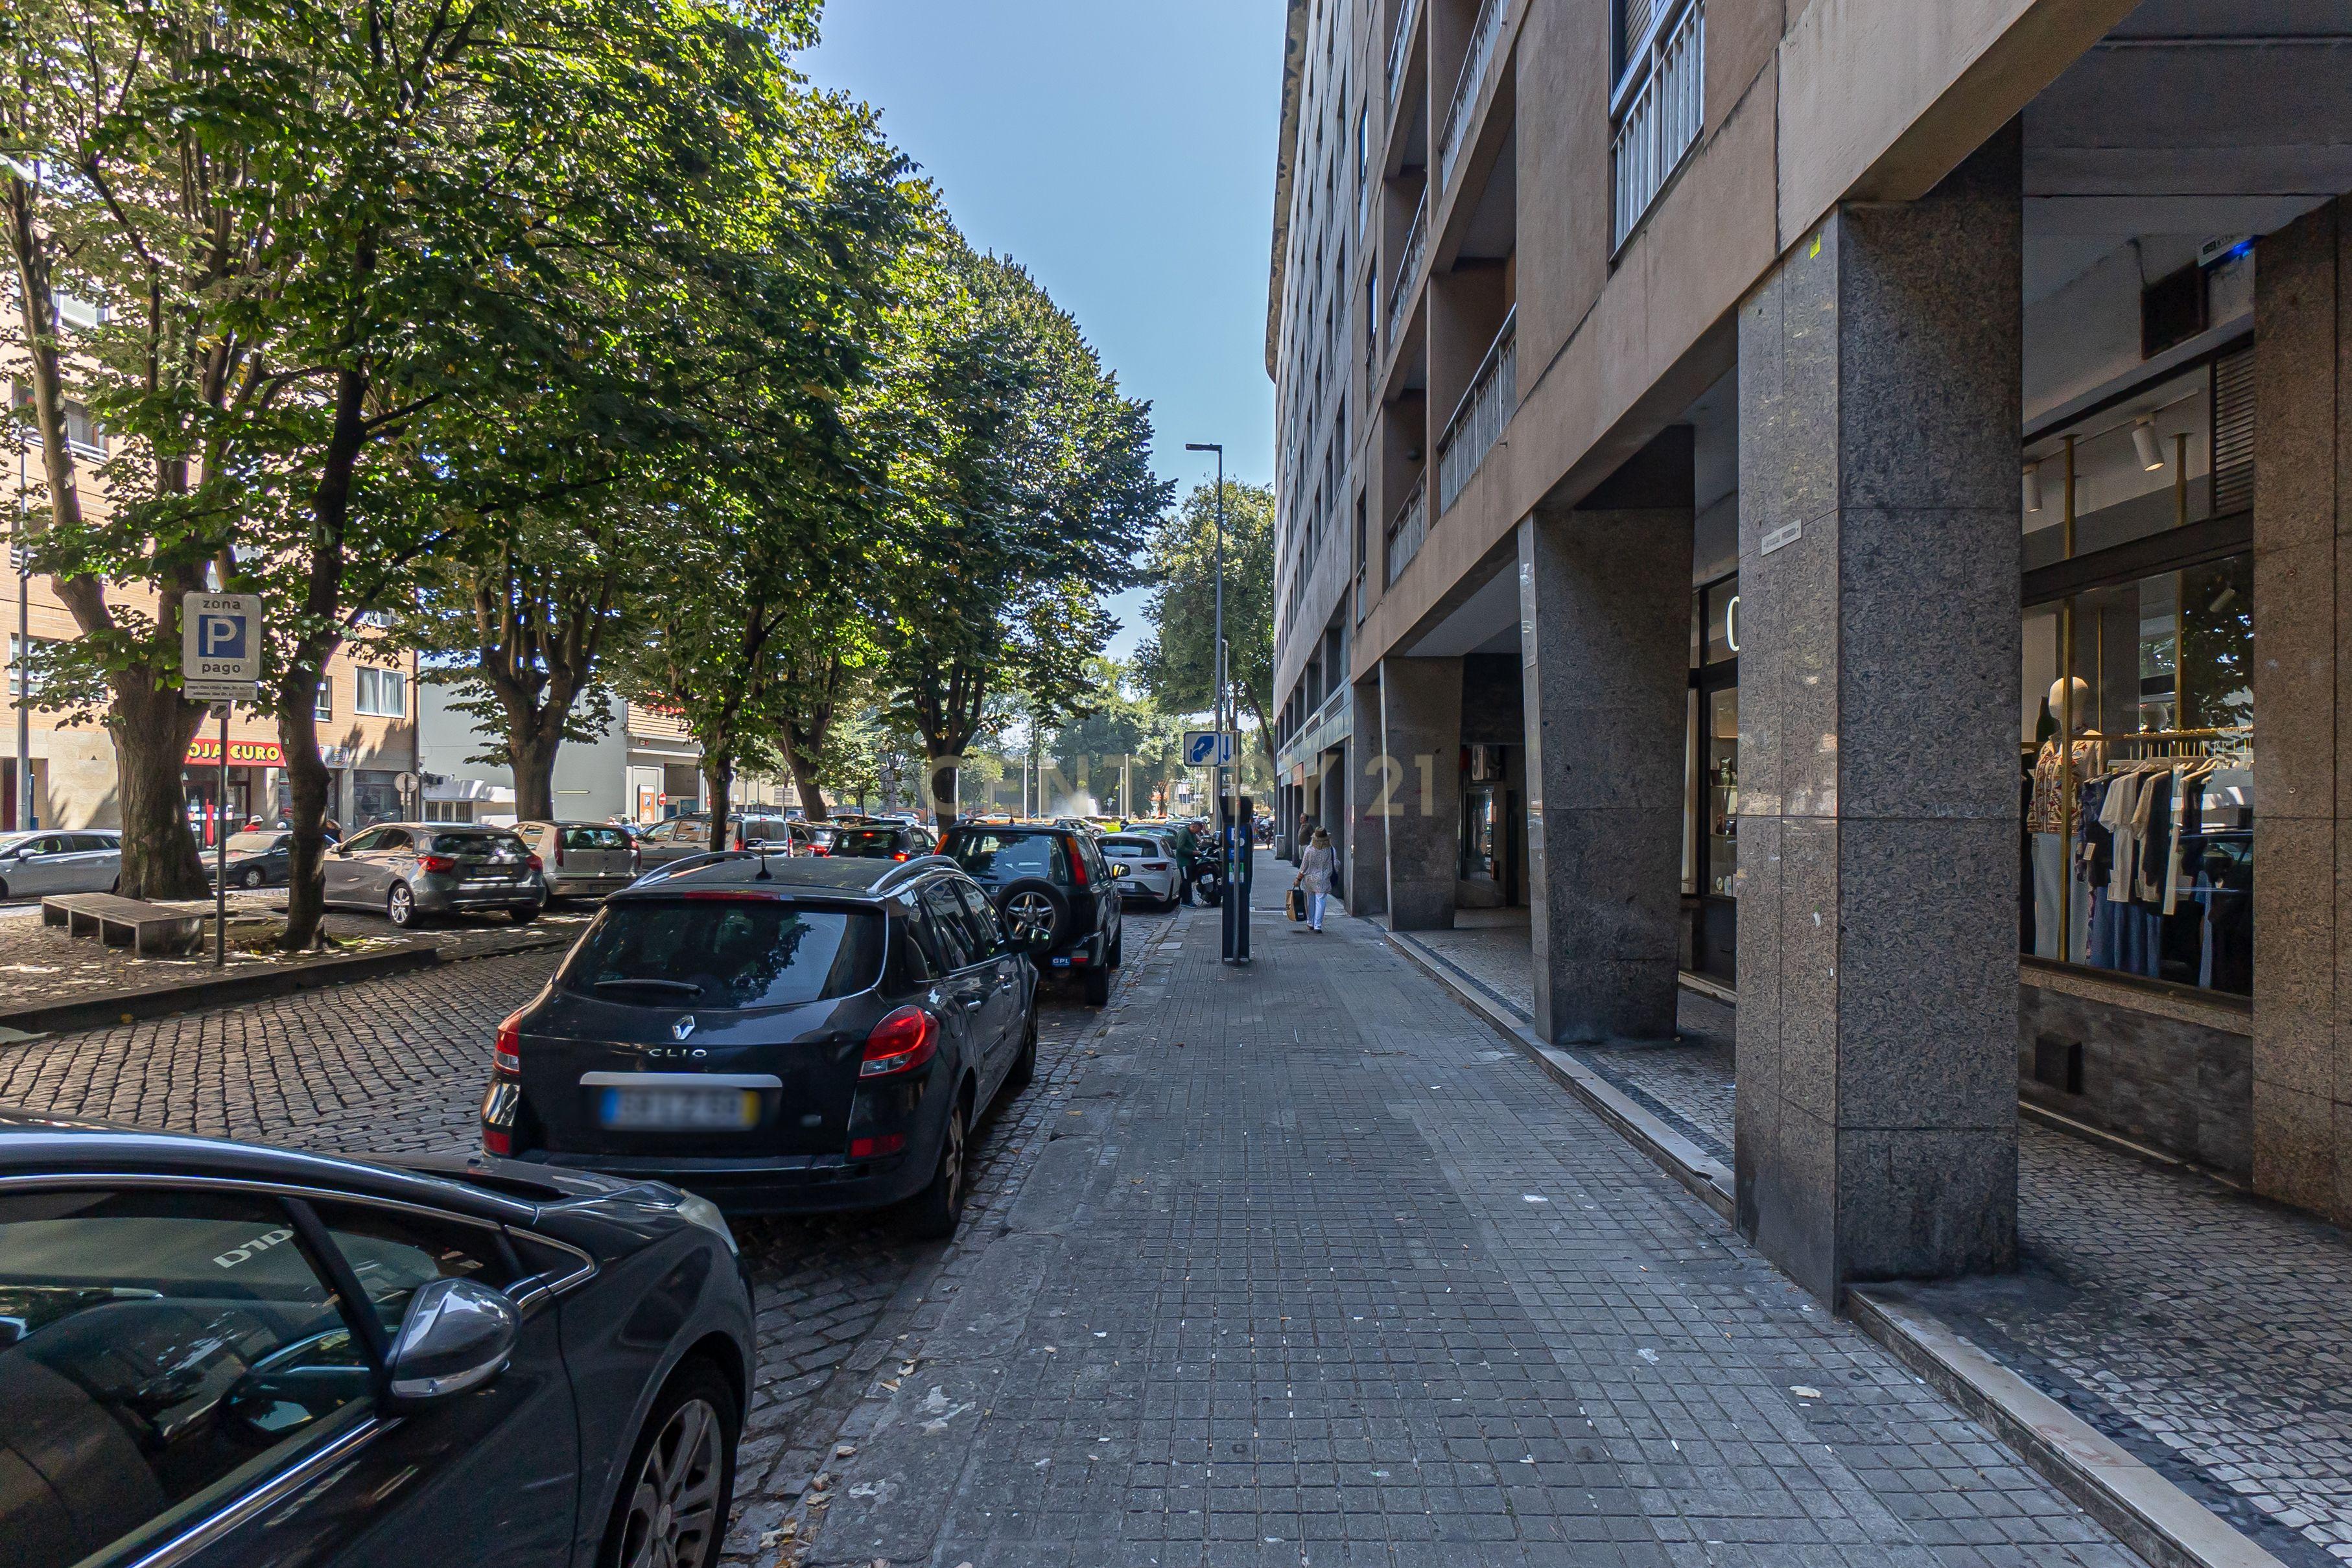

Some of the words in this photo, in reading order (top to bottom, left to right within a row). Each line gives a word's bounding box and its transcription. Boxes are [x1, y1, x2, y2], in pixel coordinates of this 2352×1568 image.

[202, 600, 241, 609] zona
[207, 618, 237, 655] P
[202, 663, 241, 675] pago
[187, 742, 221, 758] OJA
[648, 1048, 707, 1057] CLIO
